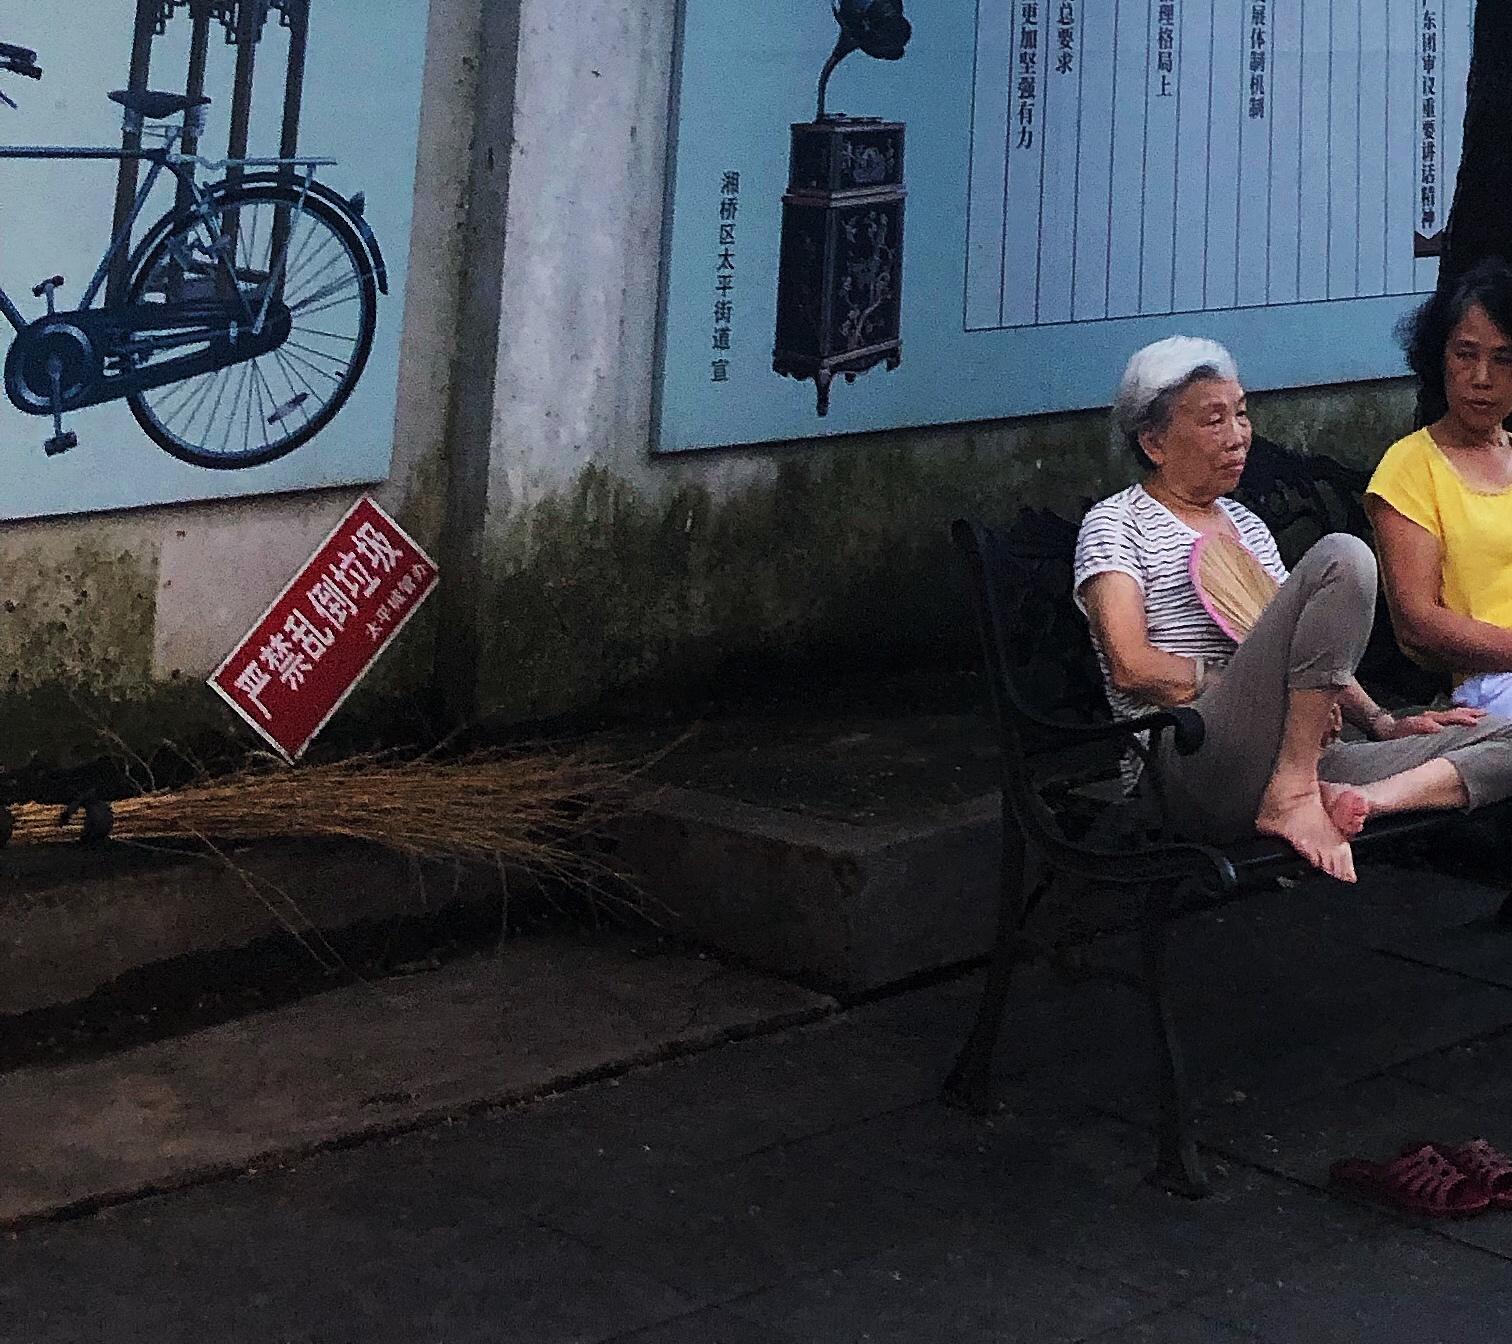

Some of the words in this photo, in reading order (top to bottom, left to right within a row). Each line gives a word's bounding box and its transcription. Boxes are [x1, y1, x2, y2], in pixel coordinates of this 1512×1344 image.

[234, 521, 404, 721] 严禁乱倒垃圾
